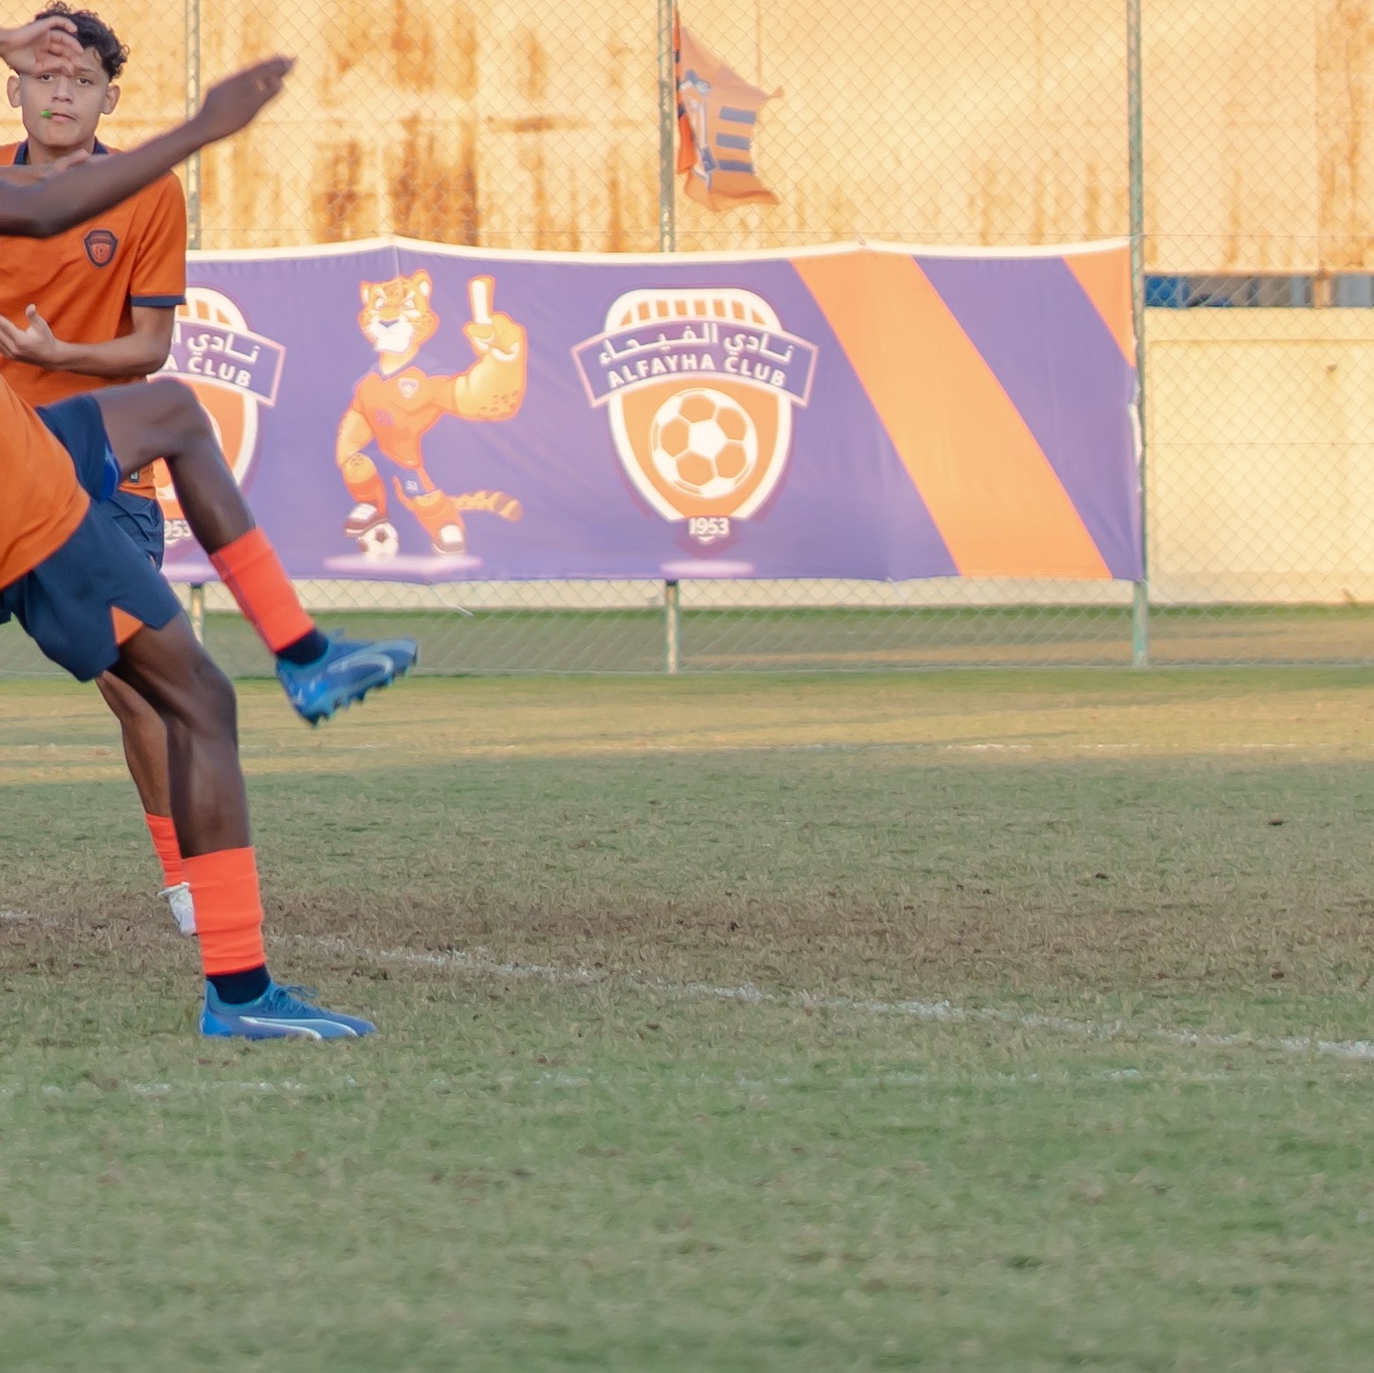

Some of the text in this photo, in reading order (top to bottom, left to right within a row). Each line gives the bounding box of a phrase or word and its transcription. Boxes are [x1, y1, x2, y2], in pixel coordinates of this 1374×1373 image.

[186, 332, 261, 364] نادي
[598, 322, 795, 366] نادي الفيحاء
[186, 355, 252, 387] CLUB
[607, 353, 787, 388] ALFAYHA CLUB
[688, 516, 730, 536] 1953
